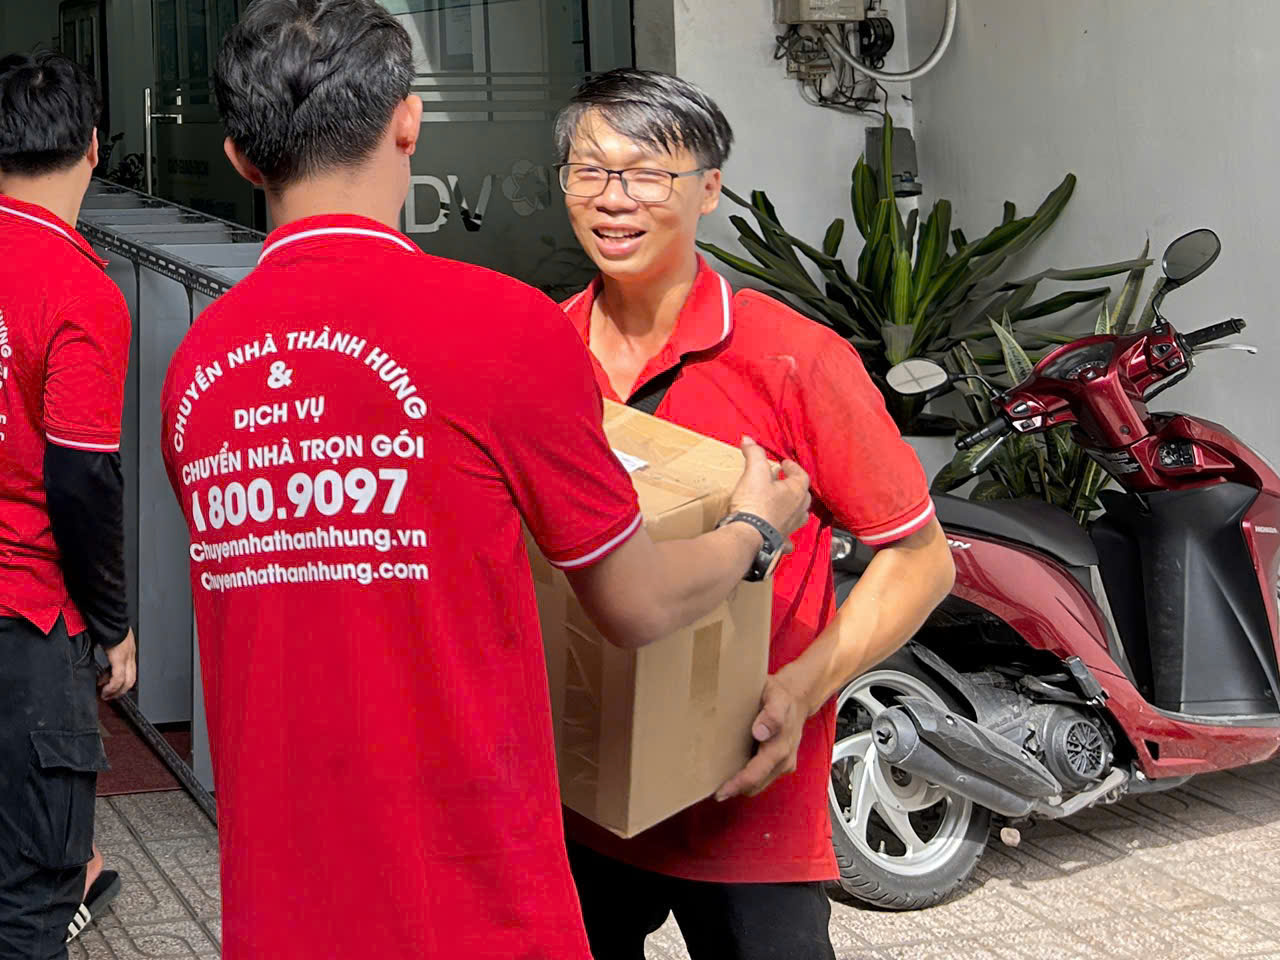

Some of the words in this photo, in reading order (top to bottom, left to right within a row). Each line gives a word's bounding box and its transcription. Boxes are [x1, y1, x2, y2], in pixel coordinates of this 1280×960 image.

[174, 360, 223, 453] CHUYỂN
[227, 332, 278, 369] NHÀ
[286, 326, 367, 359] THÀNH
[364, 346, 428, 420] HƯNG
[267, 360, 293, 389] &
[234, 402, 288, 433] DỊCH
[295, 395, 326, 424] VỤ
[182, 441, 242, 486] CHUYỂN
[247, 437, 295, 470] NHÀ
[300, 434, 363, 465] TRỌN
[370, 429, 425, 459] GÓI
[191, 467, 408, 533] 1800.9097
[189, 525, 427, 563] Chuyennhathanhhung.vn
